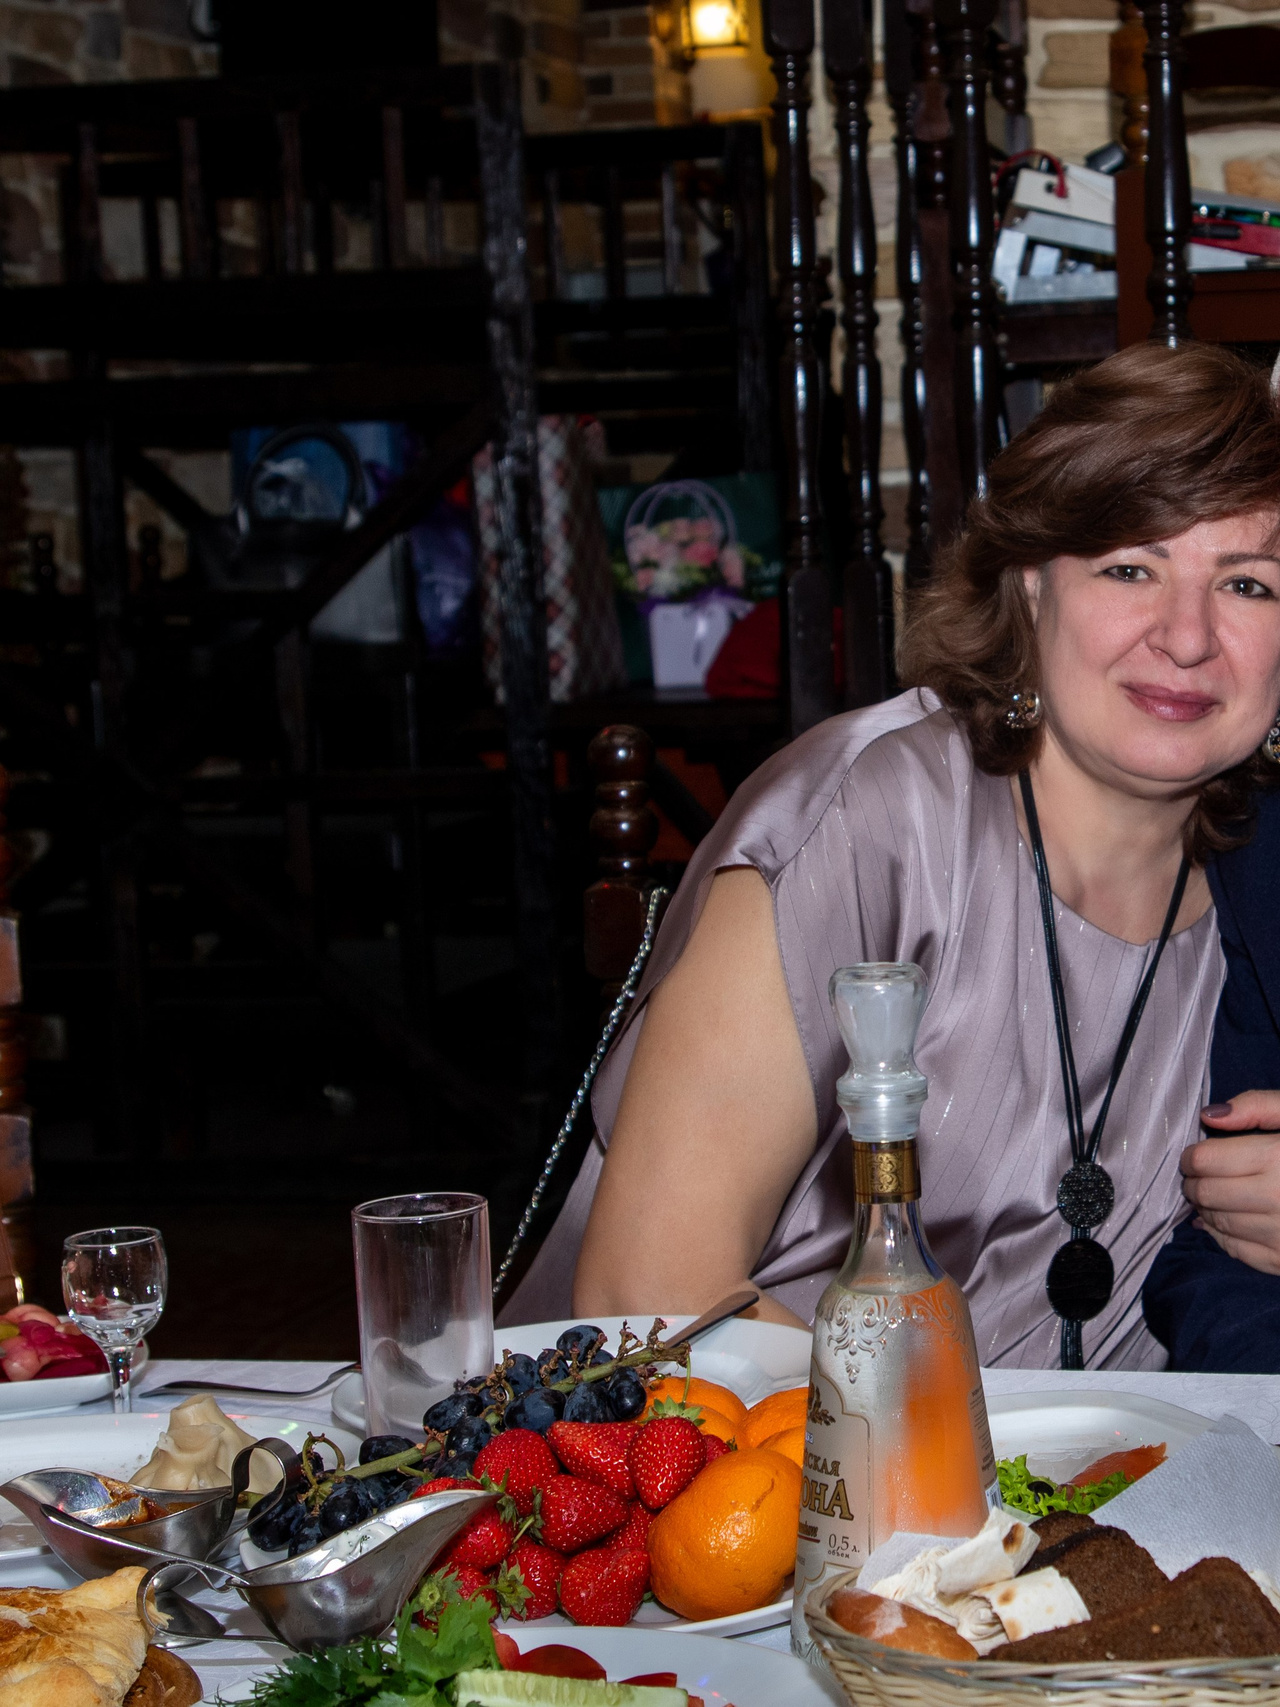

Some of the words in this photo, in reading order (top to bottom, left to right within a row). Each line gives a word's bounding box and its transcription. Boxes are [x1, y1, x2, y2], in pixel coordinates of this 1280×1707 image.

[801, 1475, 855, 1521] ОНА
[828, 1533, 850, 1552] 0,5
[827, 1548, 850, 1559] объем
